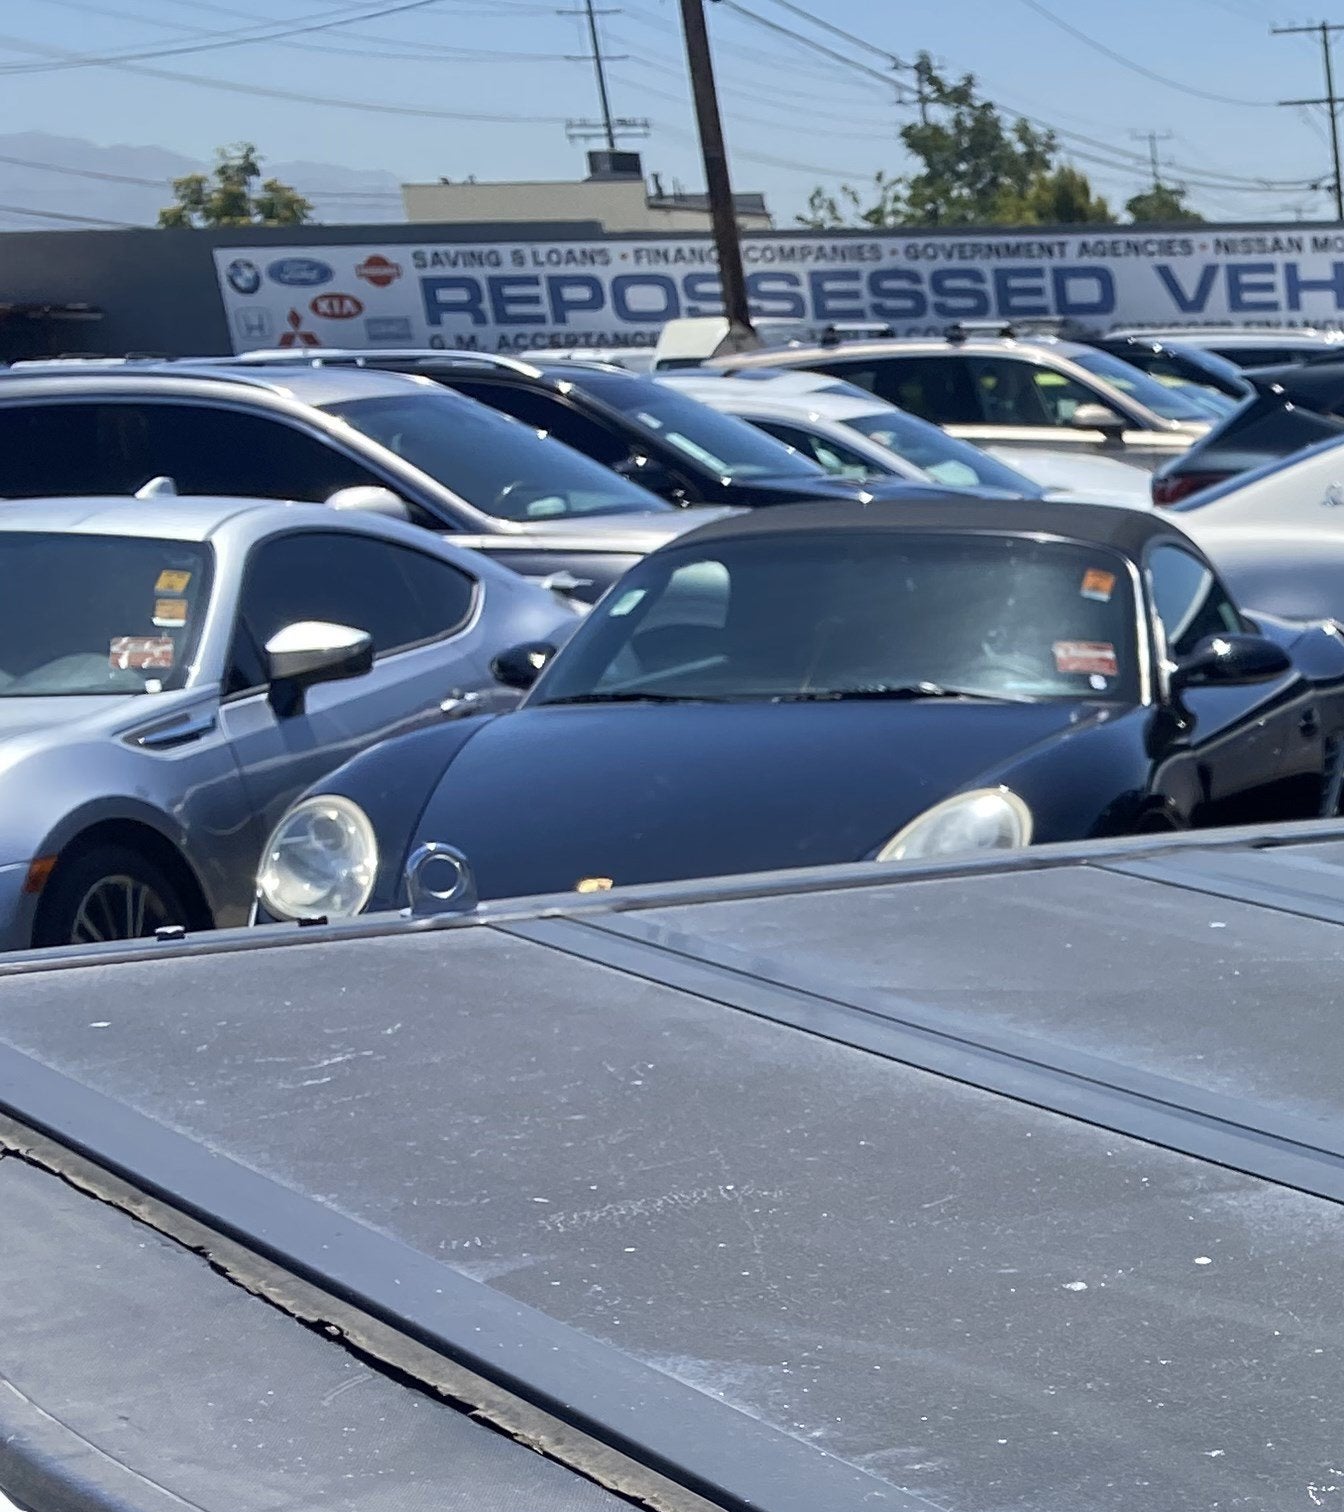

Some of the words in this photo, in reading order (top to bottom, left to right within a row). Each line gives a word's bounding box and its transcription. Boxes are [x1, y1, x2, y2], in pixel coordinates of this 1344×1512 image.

[412, 248, 502, 269] SAVING
[531, 247, 613, 267] LOANS
[633, 245, 720, 265] FINANC
[743, 242, 883, 264] COMPANIES
[904, 240, 1068, 261] GOVERNMENT
[1077, 237, 1193, 259] AGENCIES
[1213, 235, 1303, 255] NISSAN
[420, 266, 1116, 326] REPOSSESSED
